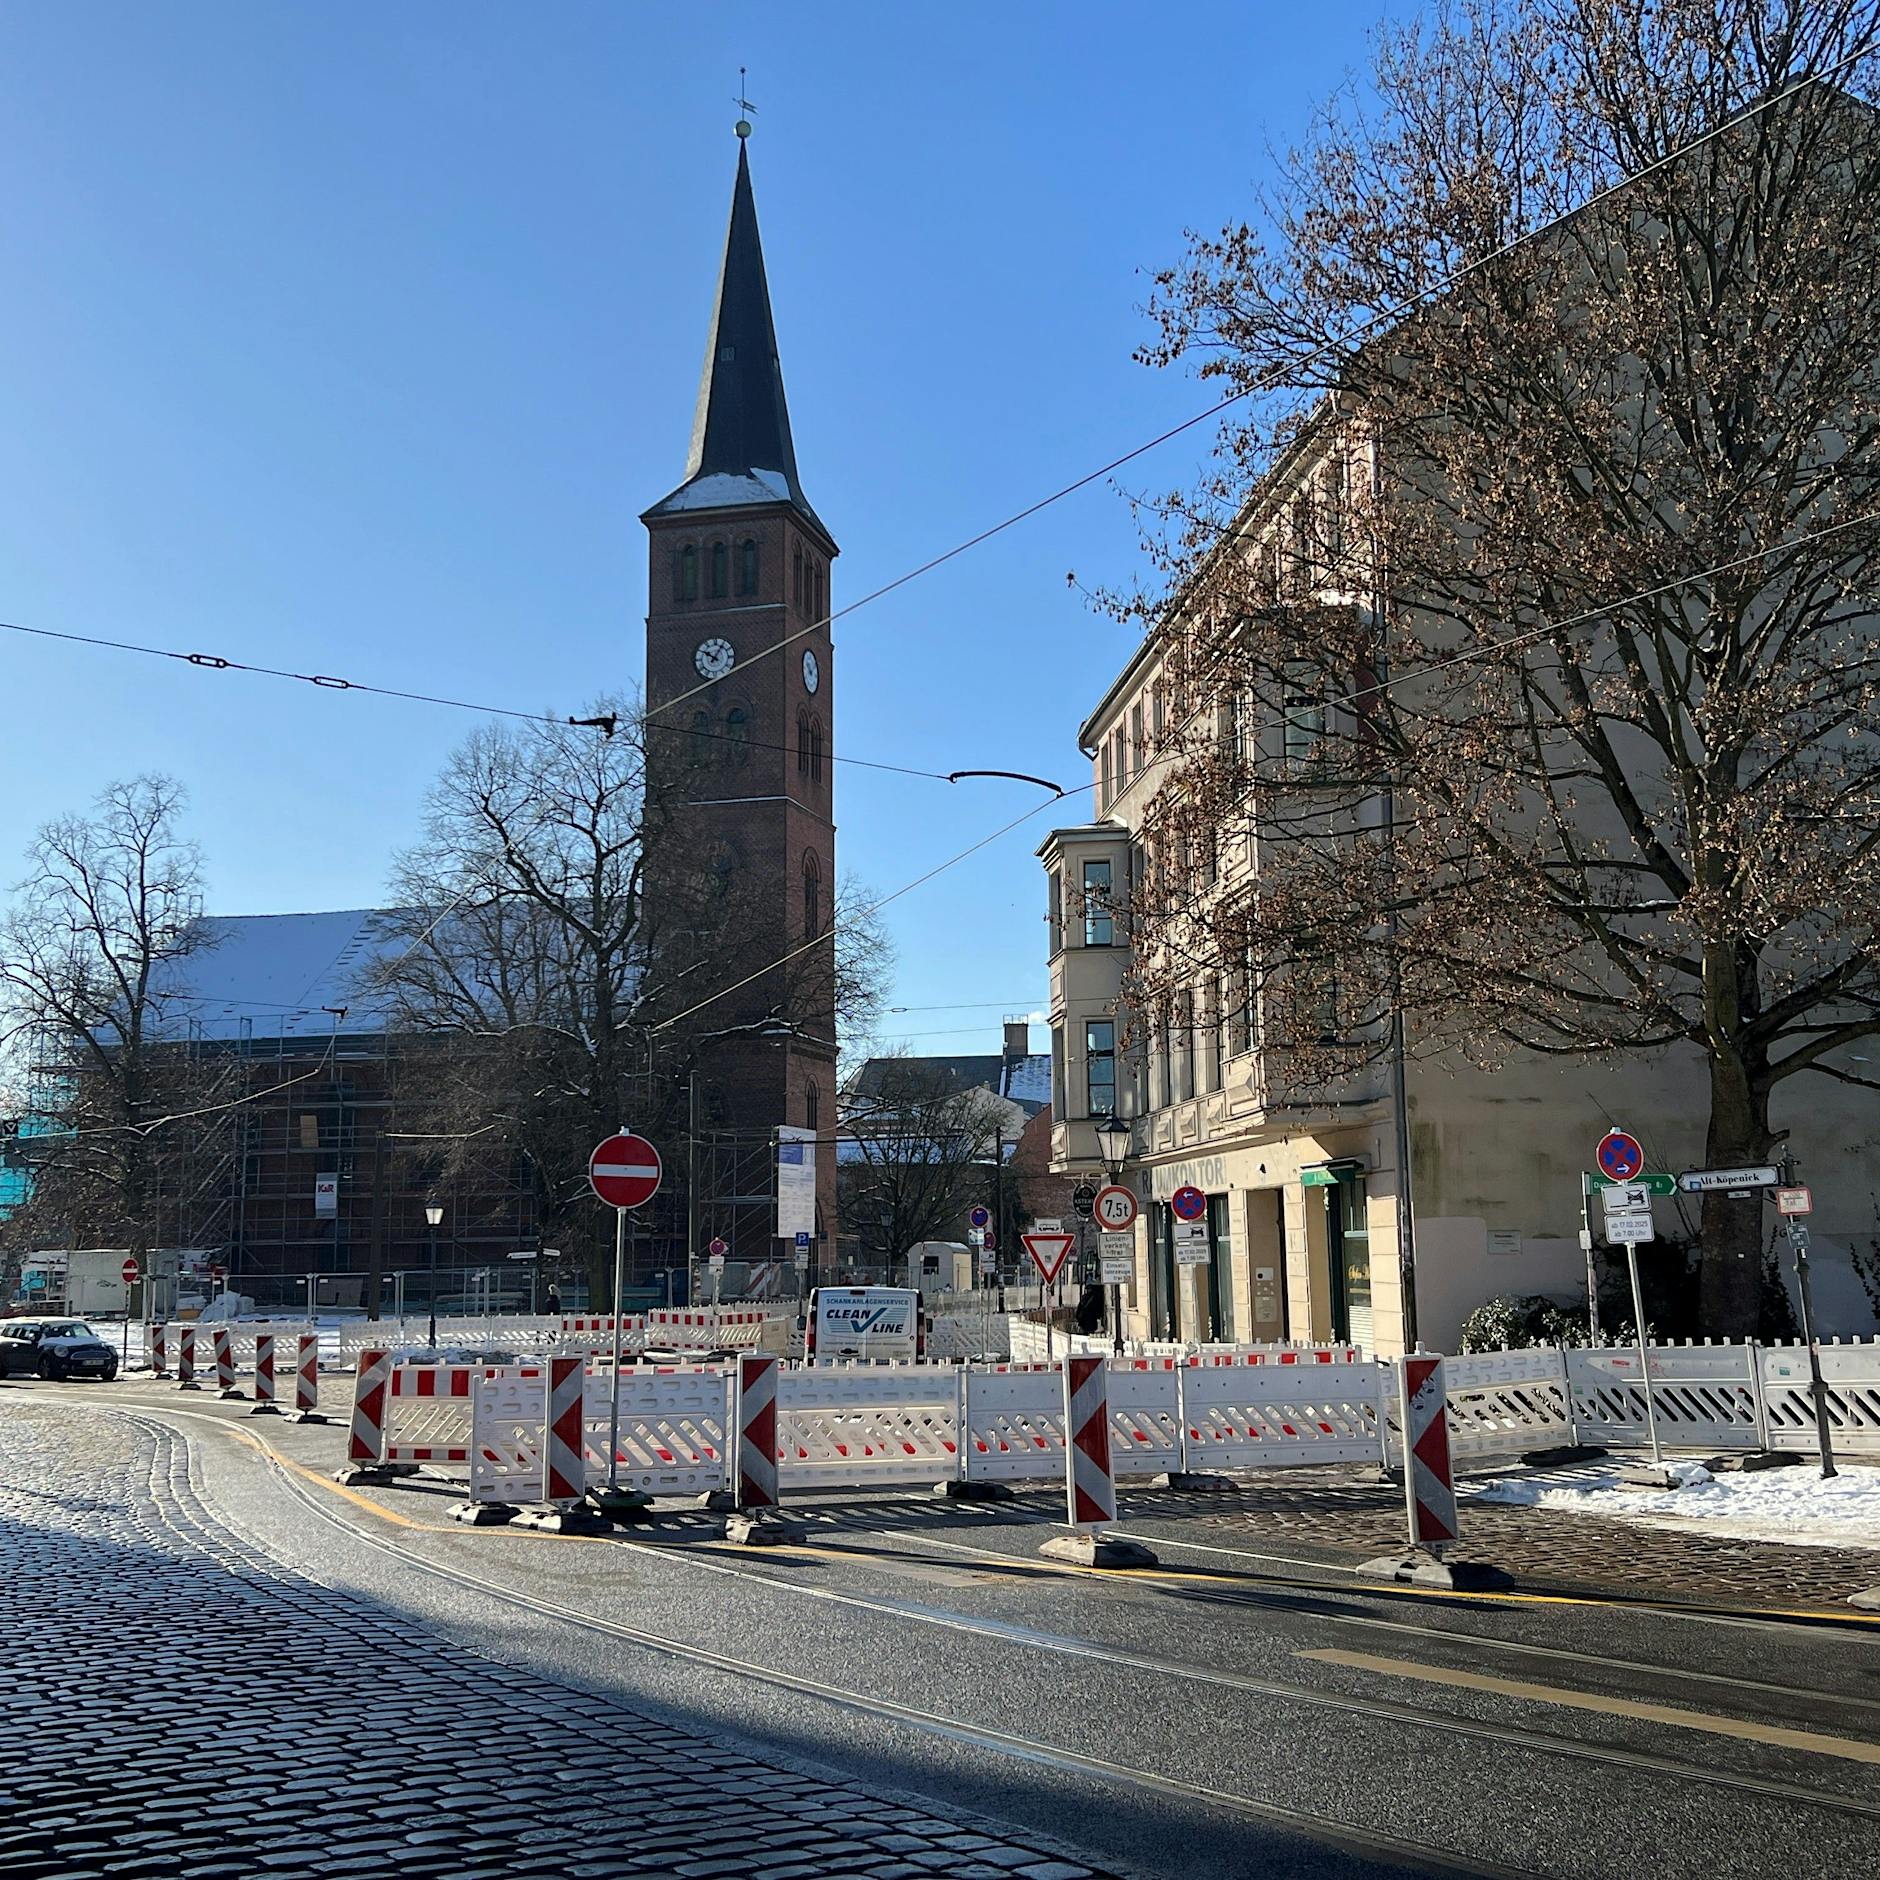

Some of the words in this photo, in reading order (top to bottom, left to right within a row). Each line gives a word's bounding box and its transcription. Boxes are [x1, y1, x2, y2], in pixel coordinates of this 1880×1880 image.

[1700, 1173, 1760, 1185] Alt-Köpenick
[826, 1309, 871, 1319] CLEAN
[872, 1323, 904, 1333] LINE
